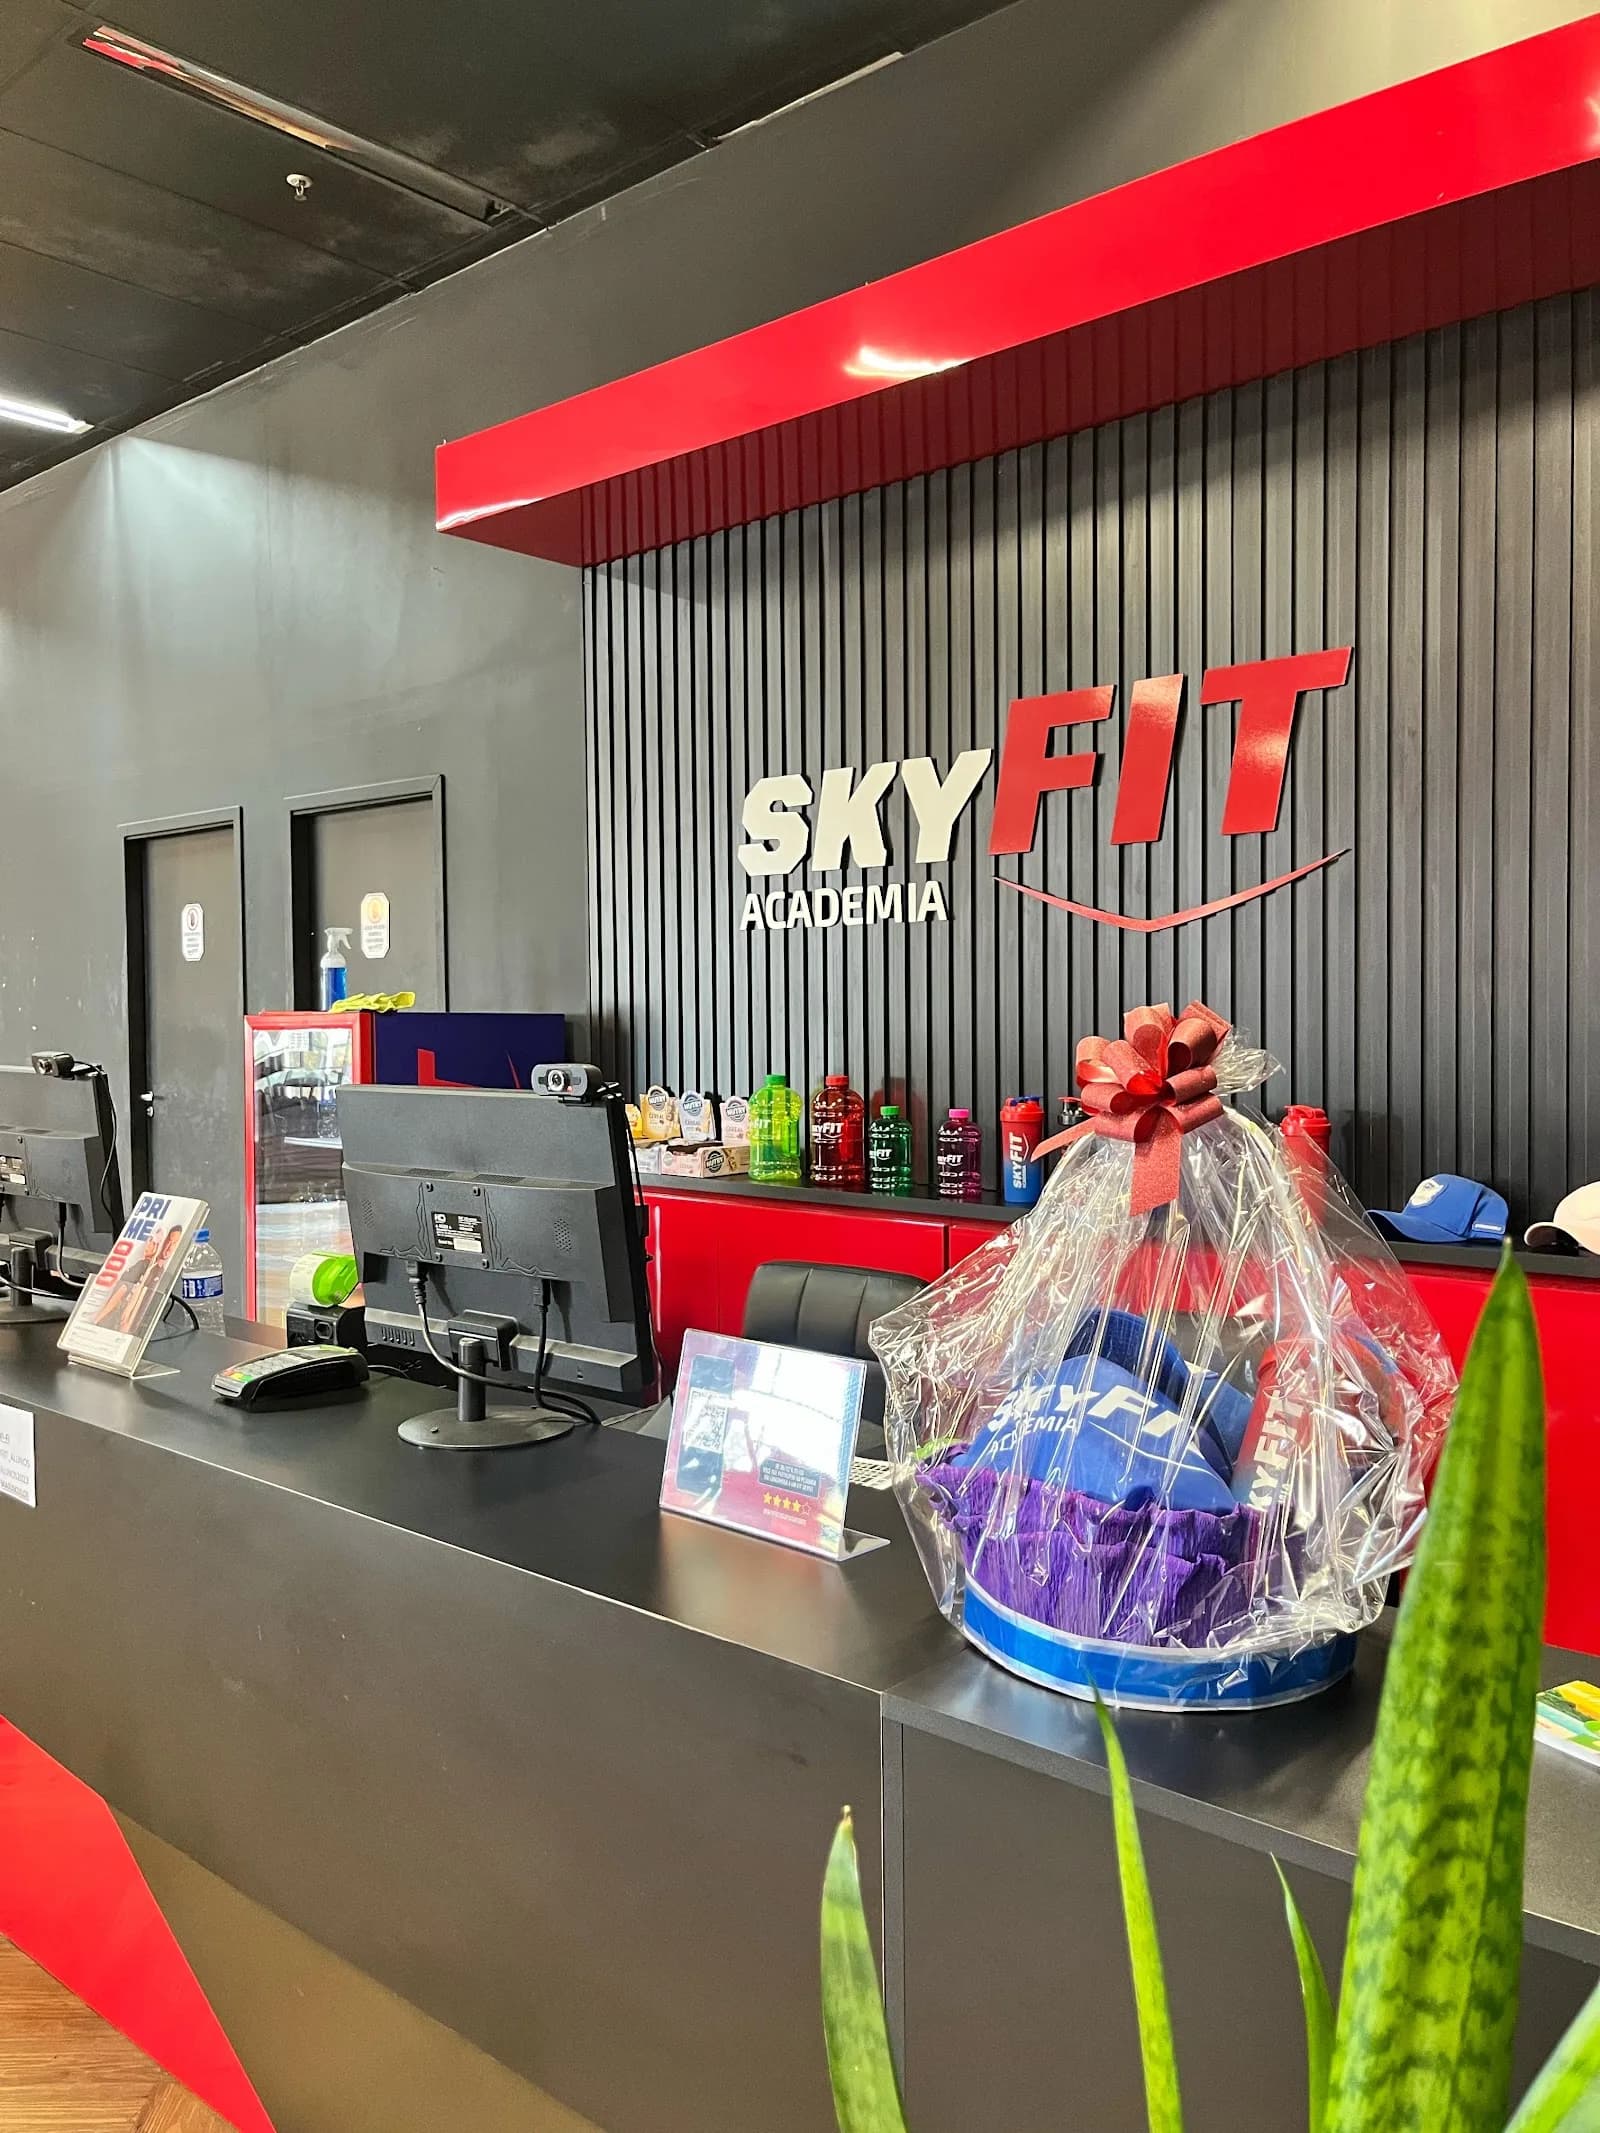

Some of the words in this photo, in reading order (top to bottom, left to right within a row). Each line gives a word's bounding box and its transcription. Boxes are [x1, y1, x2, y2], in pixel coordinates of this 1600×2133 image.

[740, 880, 948, 931] ACADEMIA
[1009, 1131, 1023, 1189] SKYFIT
[123, 1218, 157, 1242] ME
[135, 1196, 172, 1220] PRI
[987, 1384, 1204, 1461] SKYFI
